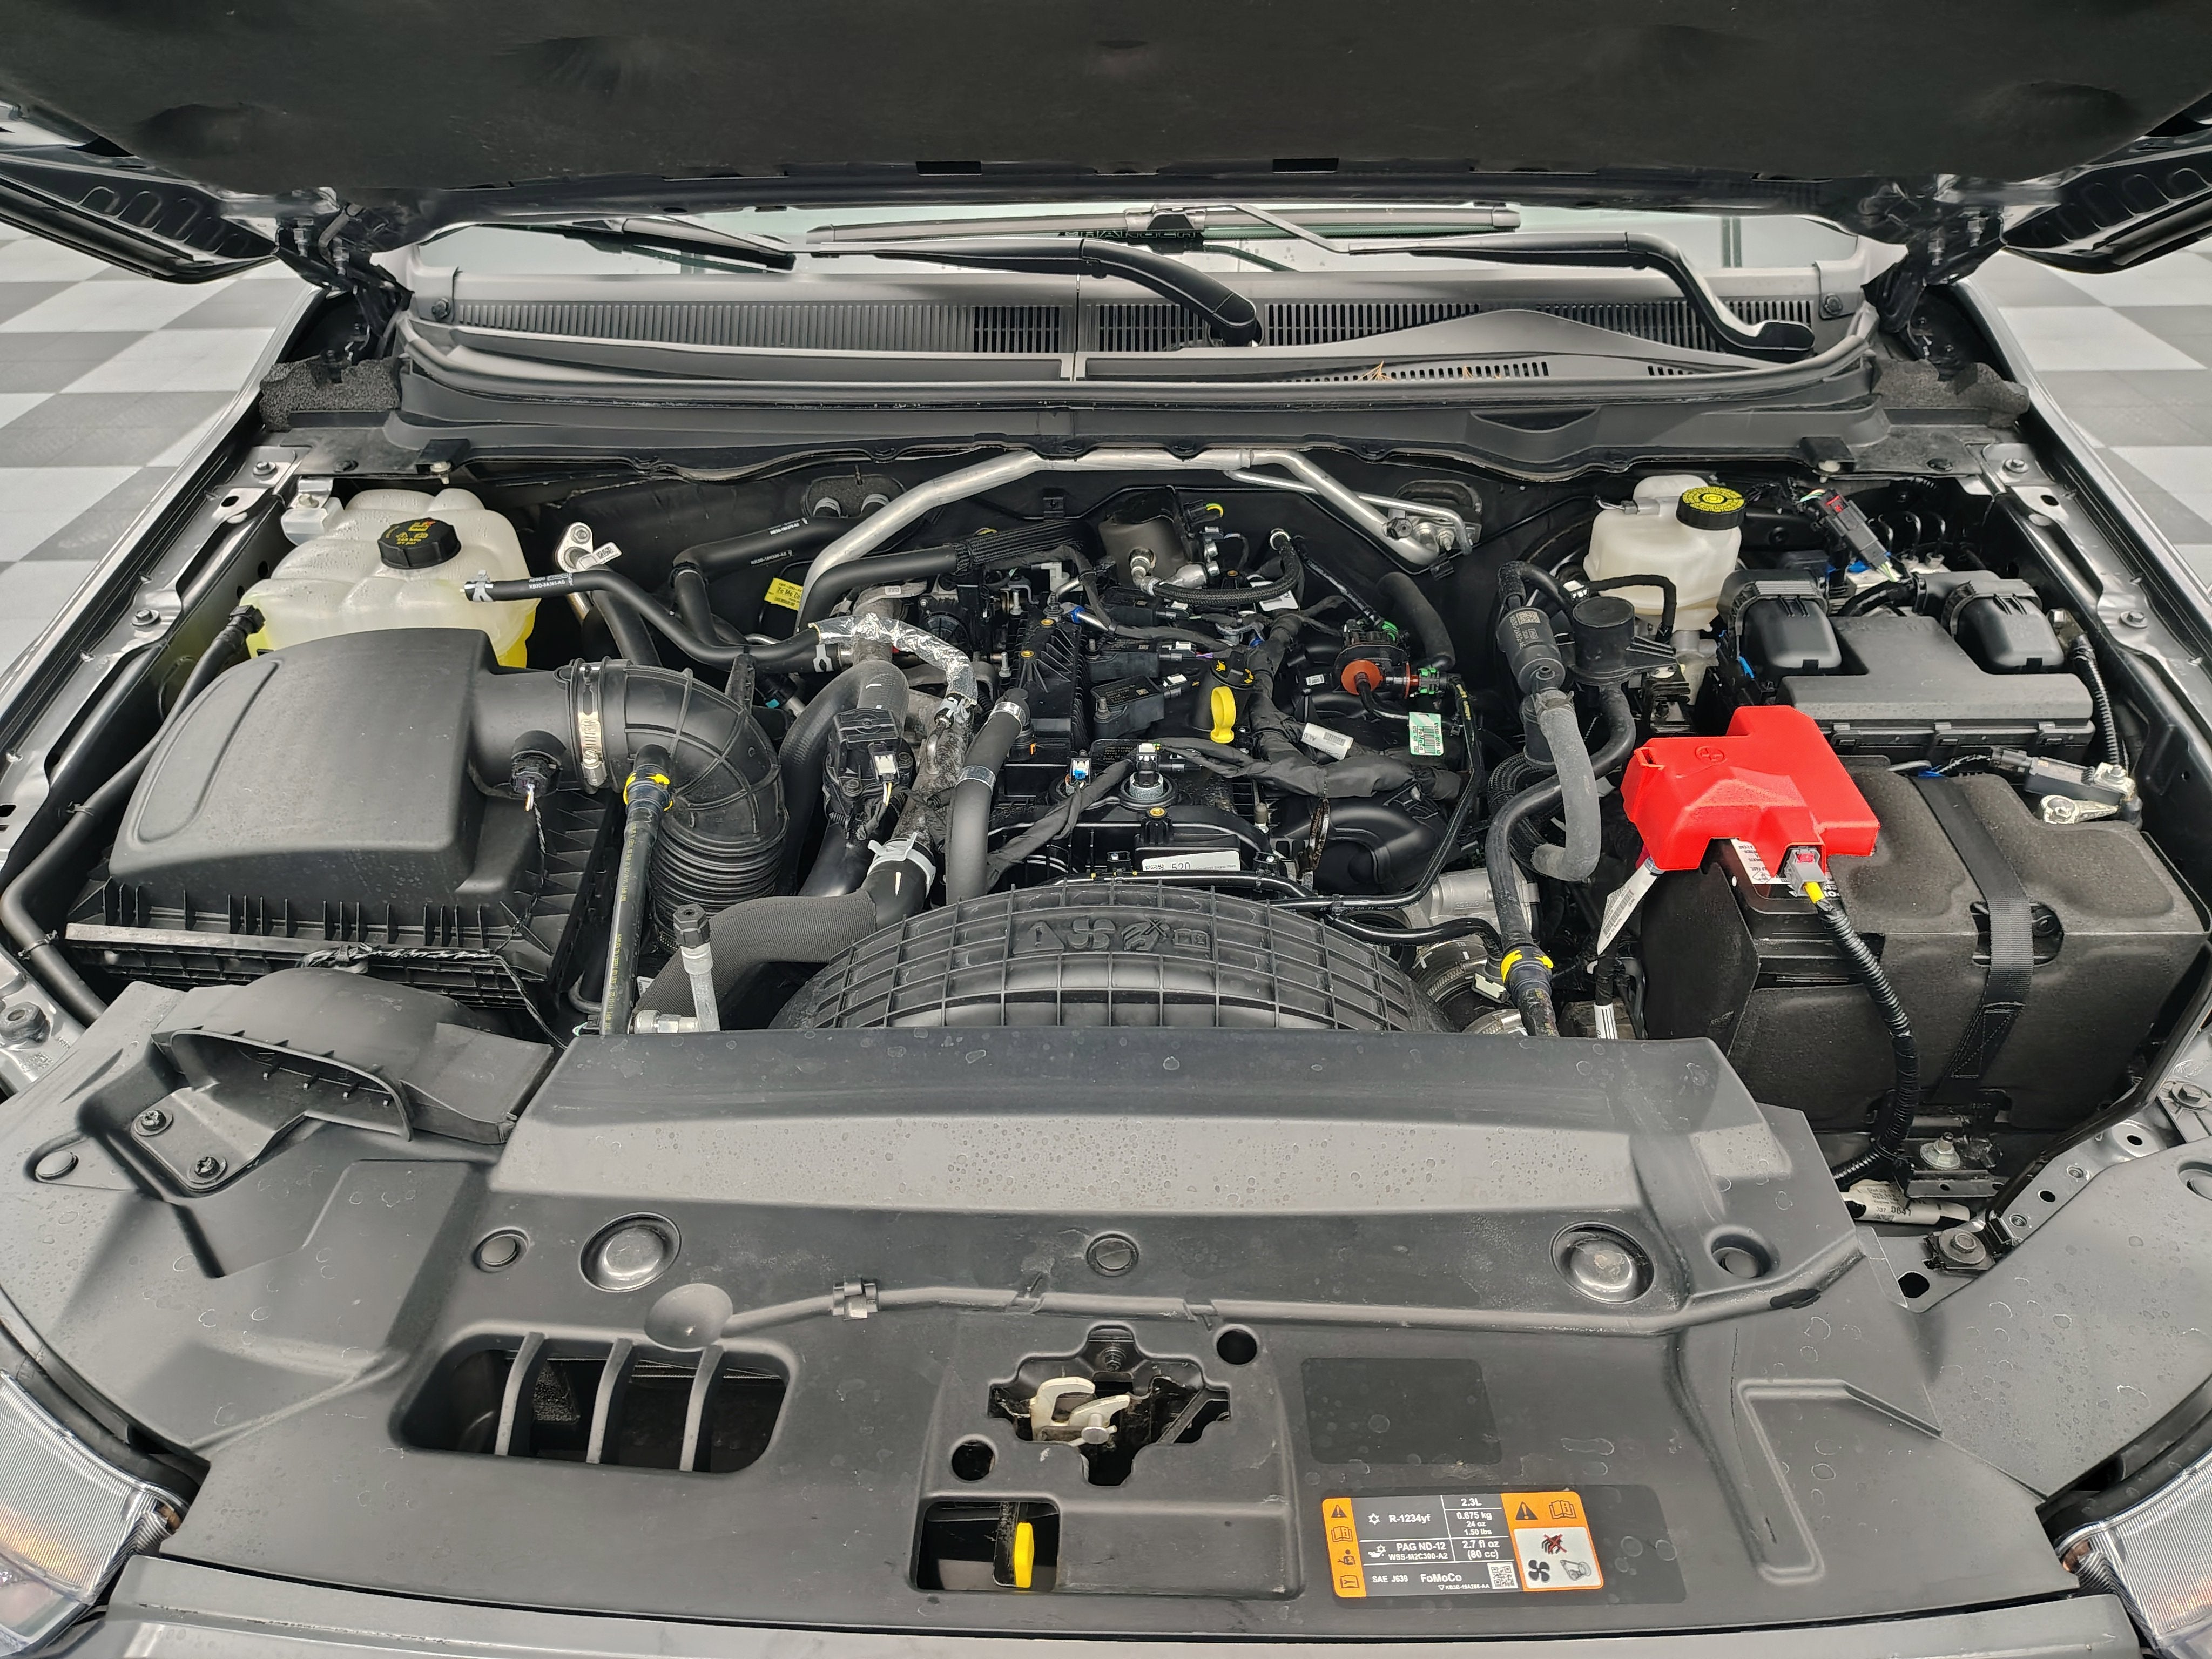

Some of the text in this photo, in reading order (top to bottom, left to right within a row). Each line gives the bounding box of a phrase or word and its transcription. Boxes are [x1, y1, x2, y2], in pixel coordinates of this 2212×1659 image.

[1460, 1498, 1482, 1507] 2.3L
[1388, 1514, 1432, 1525] R-1234yf
[1456, 1512, 1493, 1520] 0.675 kg
[1396, 1541, 1447, 1552] PAG ND-12
[1461, 1540, 1477, 1549] 2.7
[1478, 1540, 1486, 1548] fl
[1467, 1549, 1499, 1560] (80 cc)
[1420, 1573, 1462, 1583] FoMoCo
